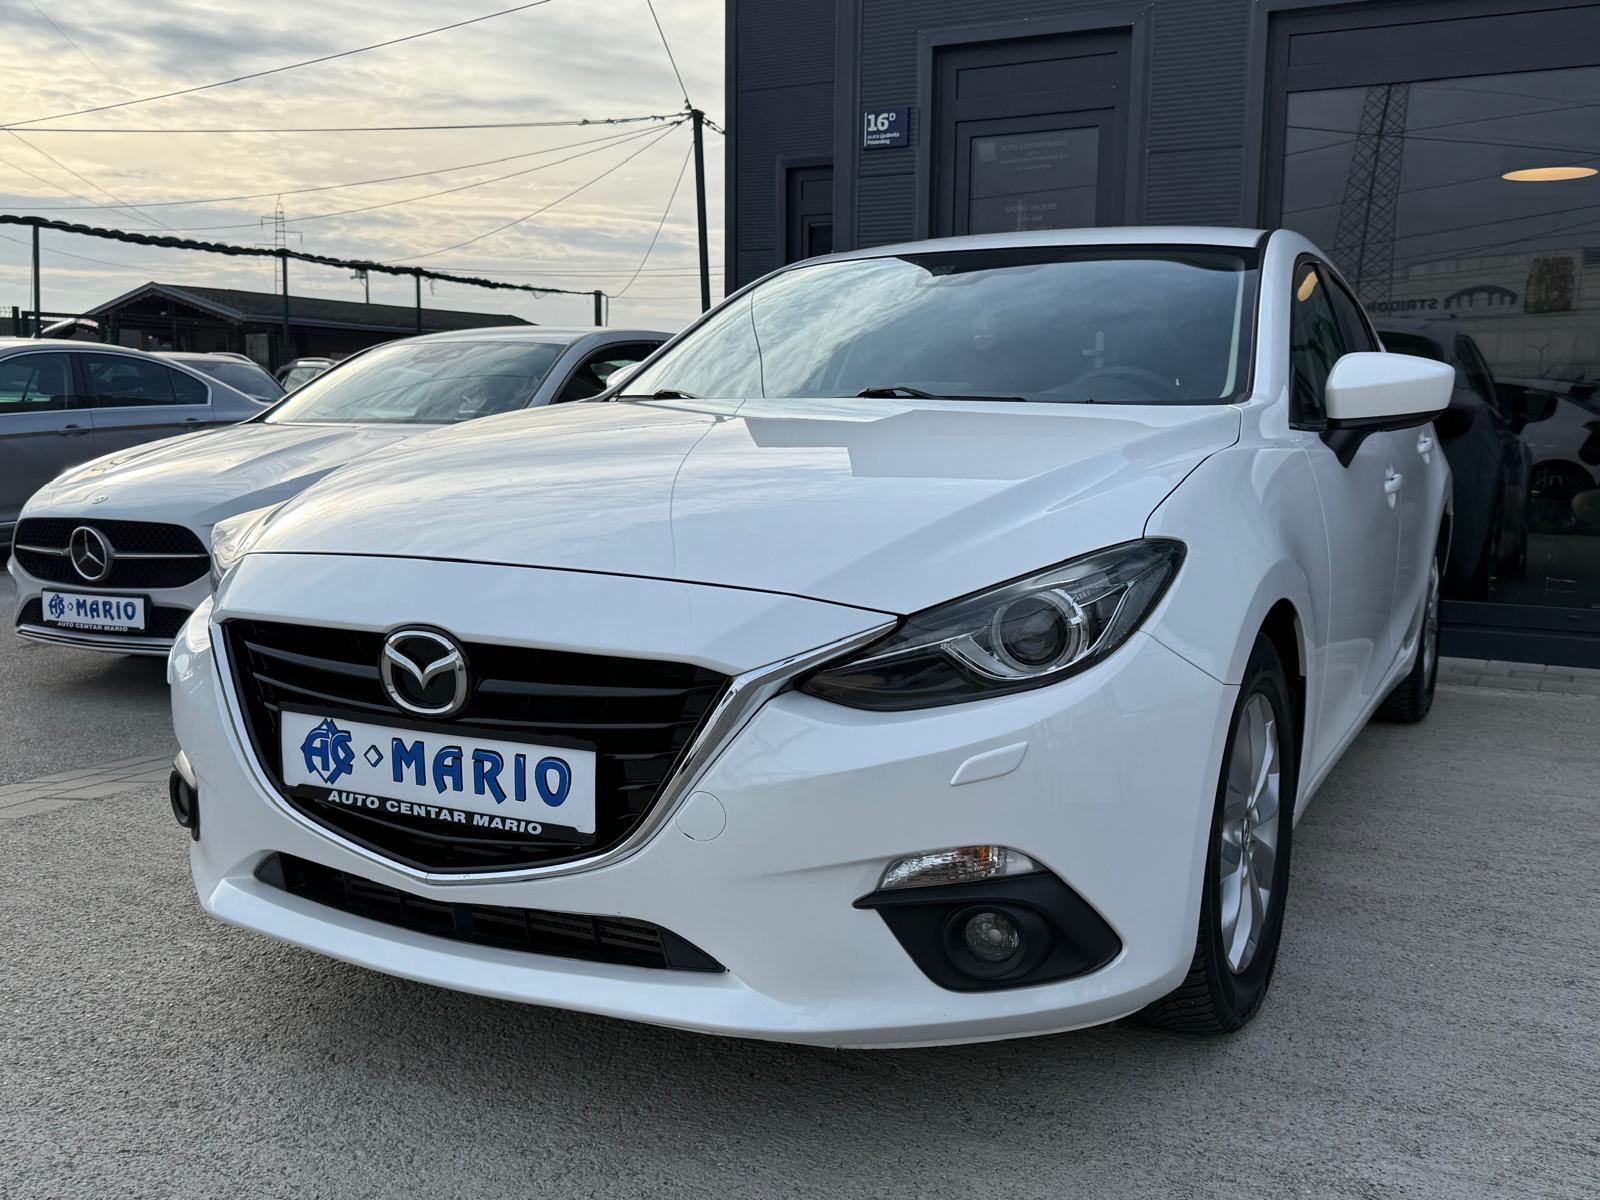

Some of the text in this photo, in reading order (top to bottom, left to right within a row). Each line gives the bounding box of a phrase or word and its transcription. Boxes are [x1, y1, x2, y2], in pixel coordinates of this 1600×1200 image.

[57, 620, 74, 628] AUTO
[75, 622, 103, 630] CENTAR
[76, 598, 137, 621] MARIO
[391, 737, 573, 808] MARIO
[328, 789, 543, 836] AUTO CENTAR MARIO
